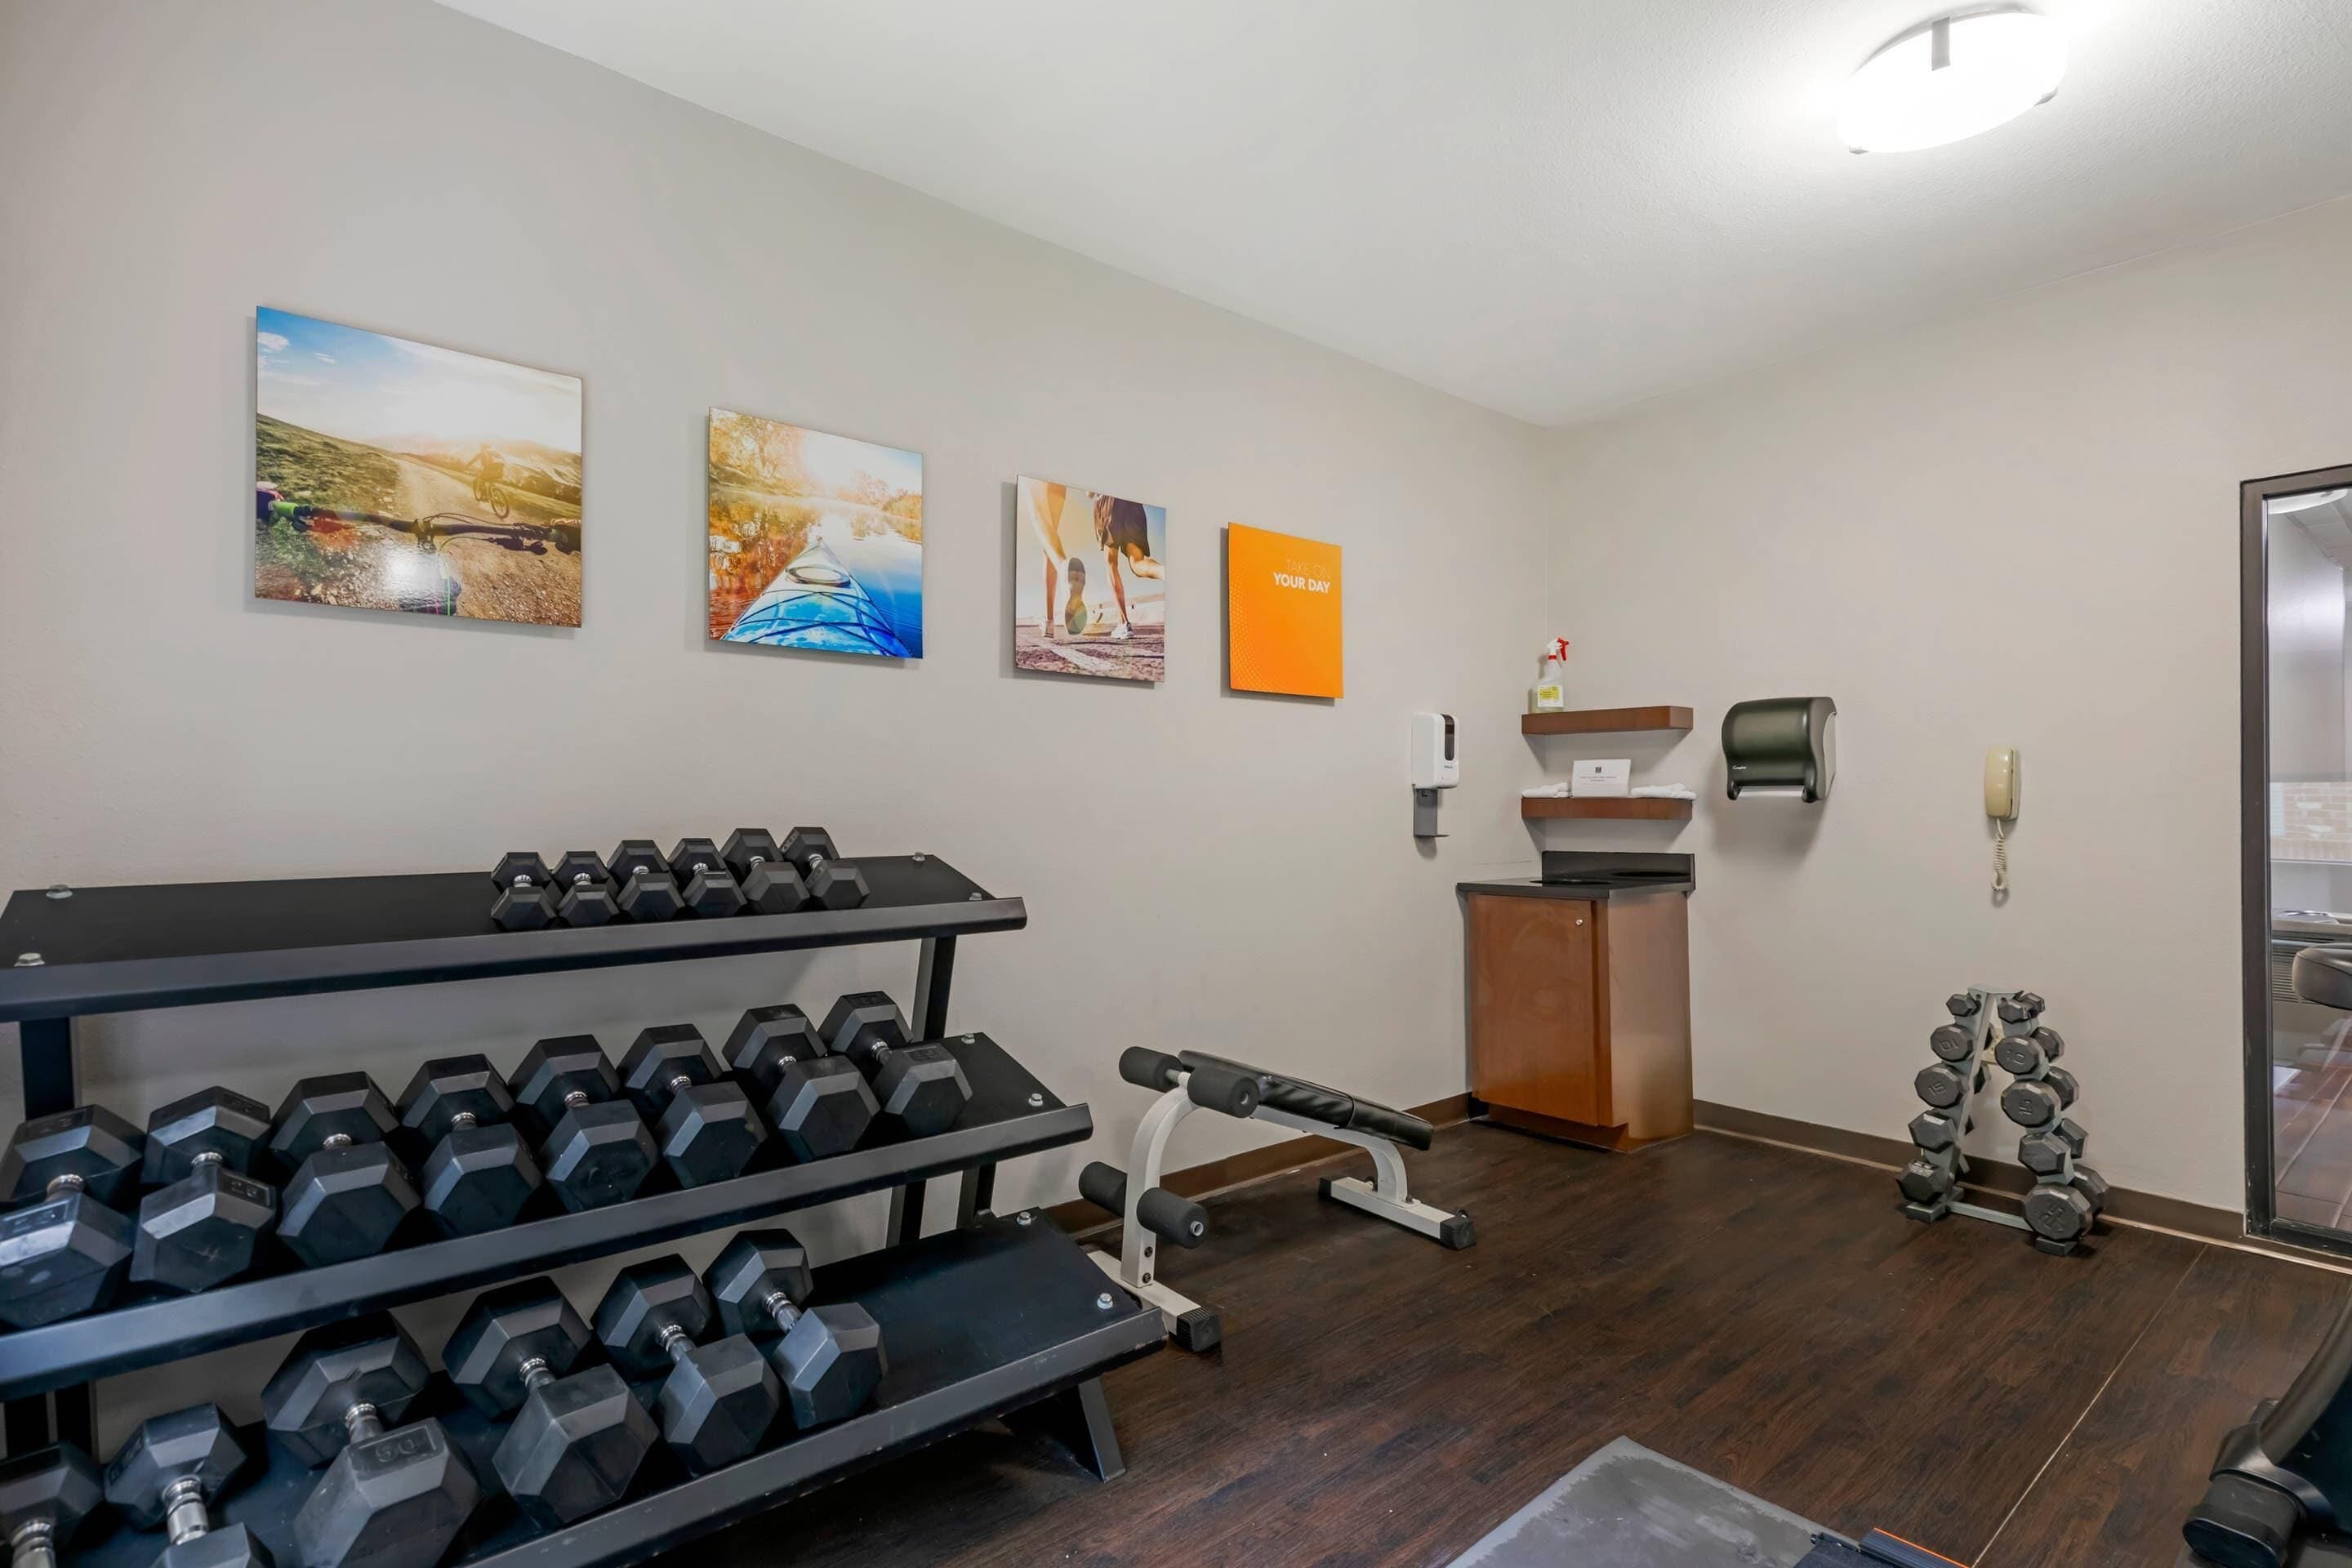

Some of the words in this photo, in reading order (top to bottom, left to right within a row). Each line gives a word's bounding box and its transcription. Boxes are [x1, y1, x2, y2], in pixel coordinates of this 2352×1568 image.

[1286, 559, 1309, 575] TAKE
[1273, 572, 1306, 590] YOUR
[1308, 578, 1331, 594] DAY
[1928, 1080, 1947, 1096] 15
